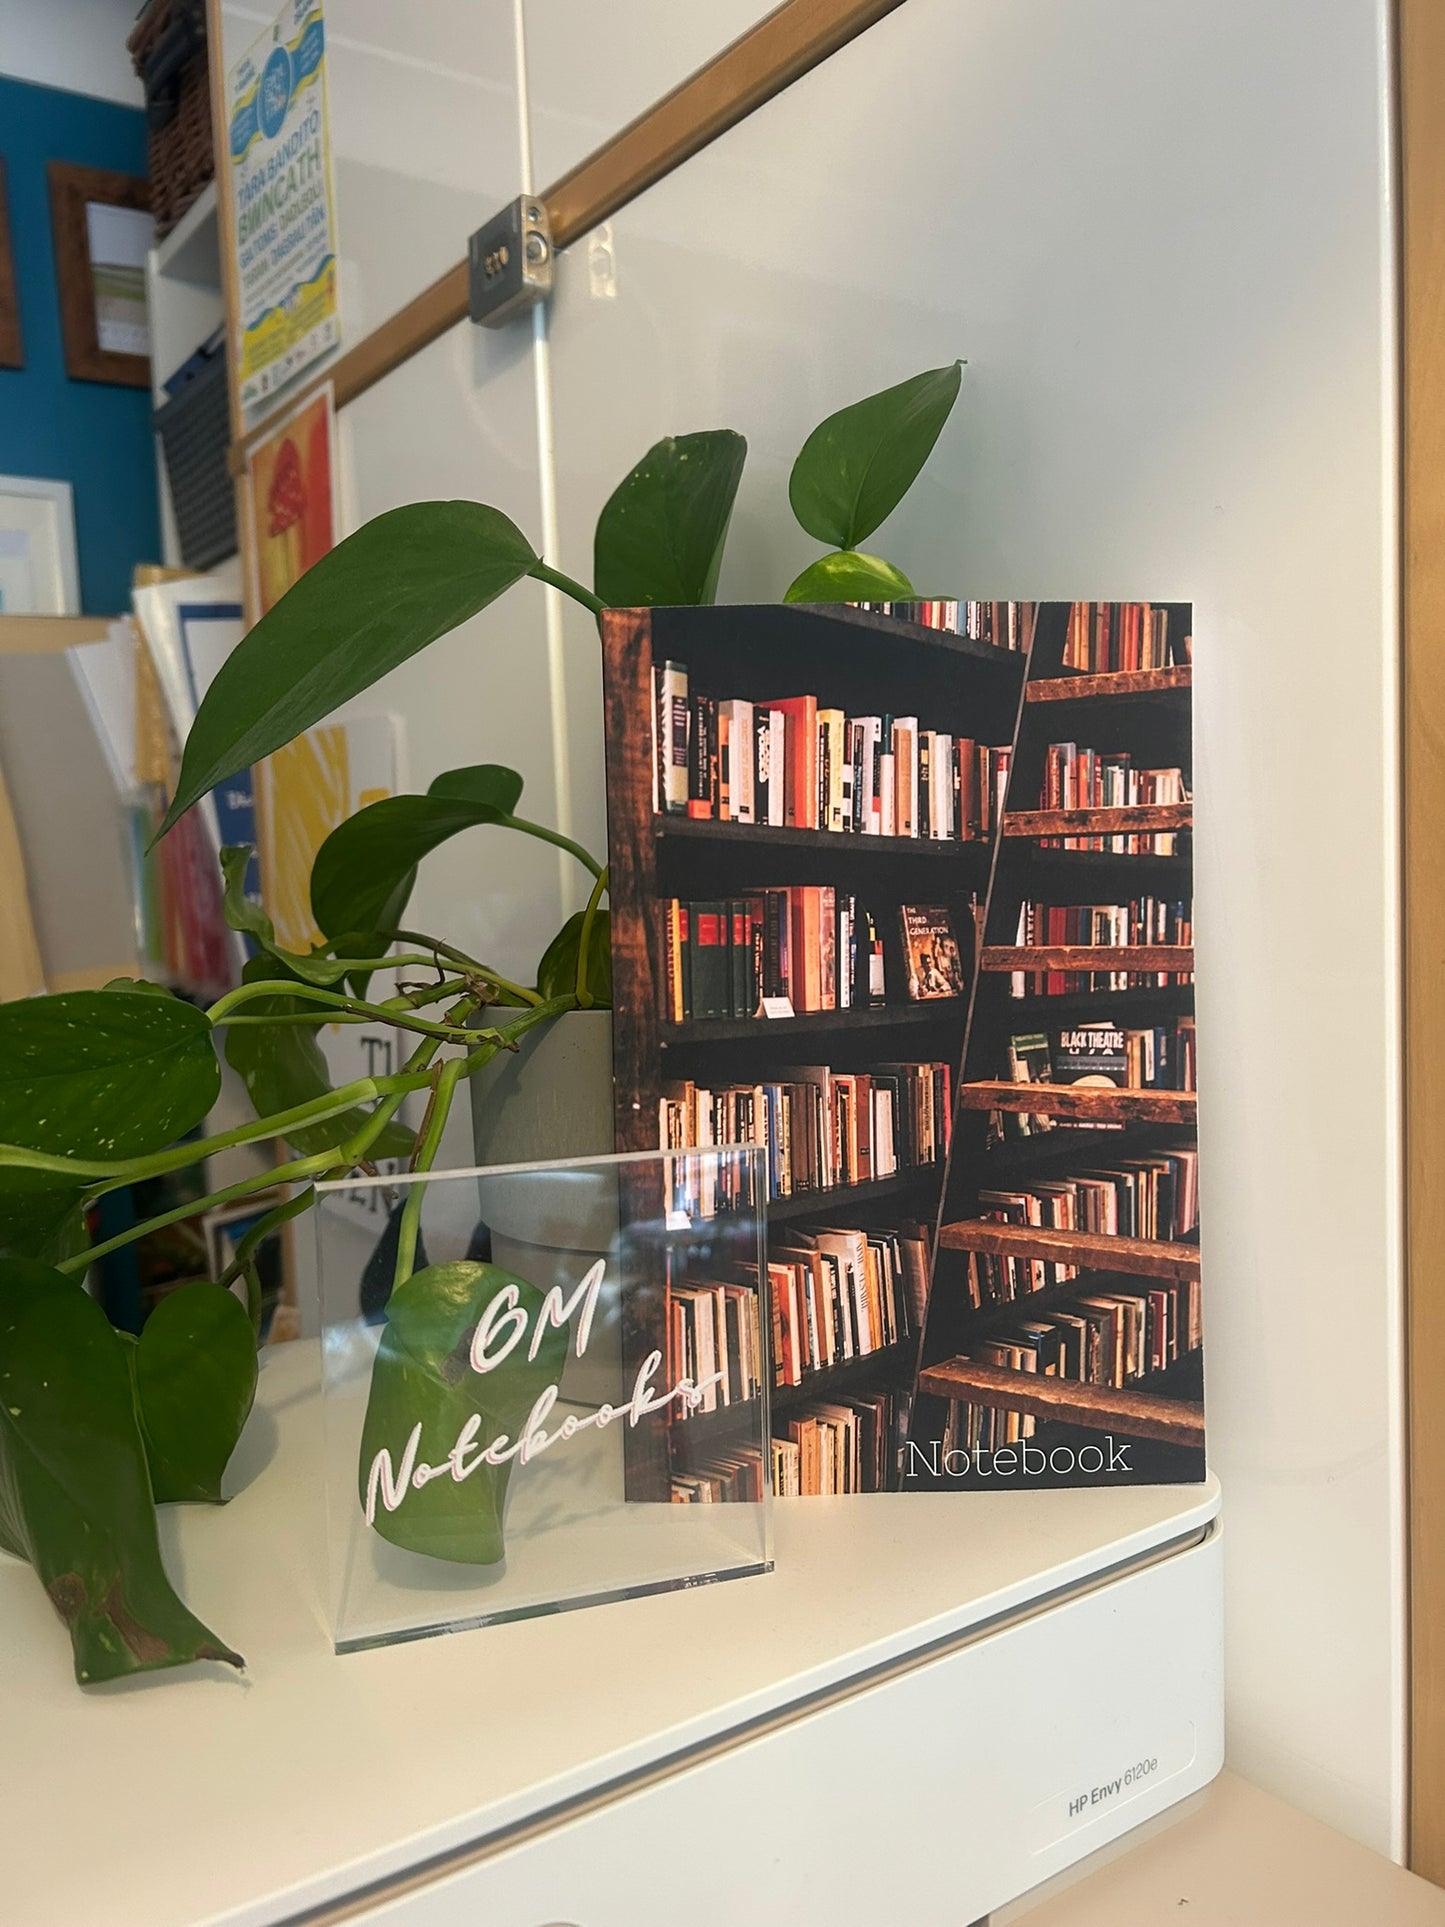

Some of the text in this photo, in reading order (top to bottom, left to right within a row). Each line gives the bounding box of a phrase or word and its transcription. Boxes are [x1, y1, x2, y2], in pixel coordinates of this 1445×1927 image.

[238, 168, 266, 210] TARA
[267, 109, 319, 180] BANDITO
[238, 137, 321, 245] BWNCATH
[907, 916, 927, 924] THIRD
[909, 926, 949, 936] GENERATION
[1060, 1031, 1087, 1048] BLACK
[1087, 1031, 1124, 1049] THEATRE
[470, 1258, 606, 1374] 6M
[365, 1349, 727, 1527] Notebooks
[906, 1436, 1133, 1477] Notebook
[1068, 1758, 1158, 1817] HP Envy 6120e
